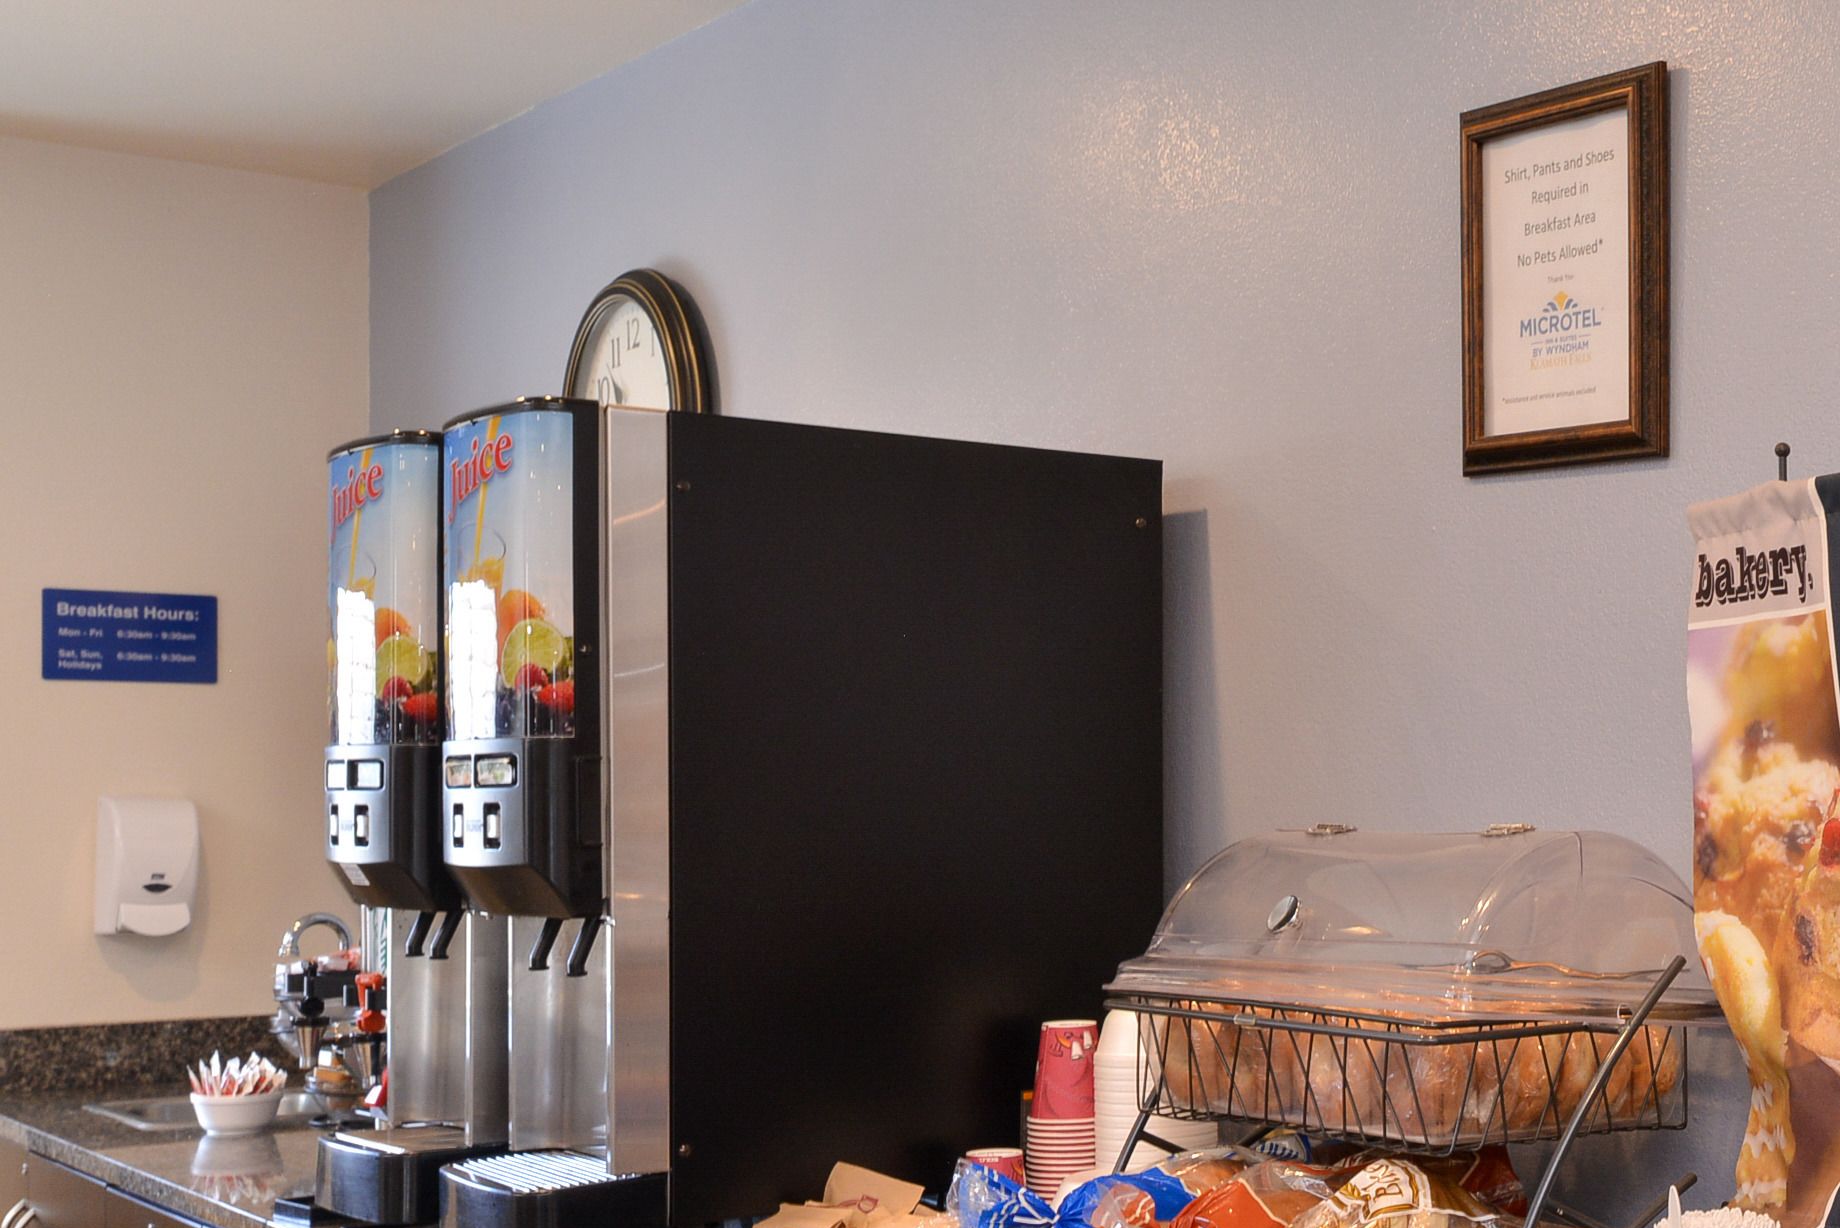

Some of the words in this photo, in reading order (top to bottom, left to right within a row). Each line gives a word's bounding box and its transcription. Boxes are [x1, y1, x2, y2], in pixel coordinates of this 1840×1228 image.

[1504, 167, 1531, 184] Shirt,
[1532, 160, 1561, 177] Pants
[1563, 154, 1584, 171] and
[1585, 149, 1615, 166] Shoes
[1531, 182, 1577, 205] Required
[1579, 181, 1589, 195] in
[1524, 215, 1571, 236] Breakfast
[1573, 211, 1596, 228] Area
[1517, 255, 1532, 268] No
[1534, 249, 1557, 265] Pets
[626, 318, 641, 351] 12
[1519, 308, 1602, 338] MICROTEL
[611, 337, 621, 369] 11
[1532, 347, 1543, 358] BY
[1546, 340, 1590, 355] WYNDHAM
[447, 432, 514, 524] Juice
[330, 463, 384, 544] Juice
[57, 602, 139, 619] Breakfast
[143, 606, 200, 621] Hours:
[58, 627, 81, 638] Mon
[89, 628, 103, 638] Fri
[116, 629, 153, 640] 6:30am
[161, 631, 197, 641] 9:30am
[58, 660, 103, 672] Holidays
[116, 651, 153, 662] 6:30am
[161, 653, 197, 663] 9:30am
